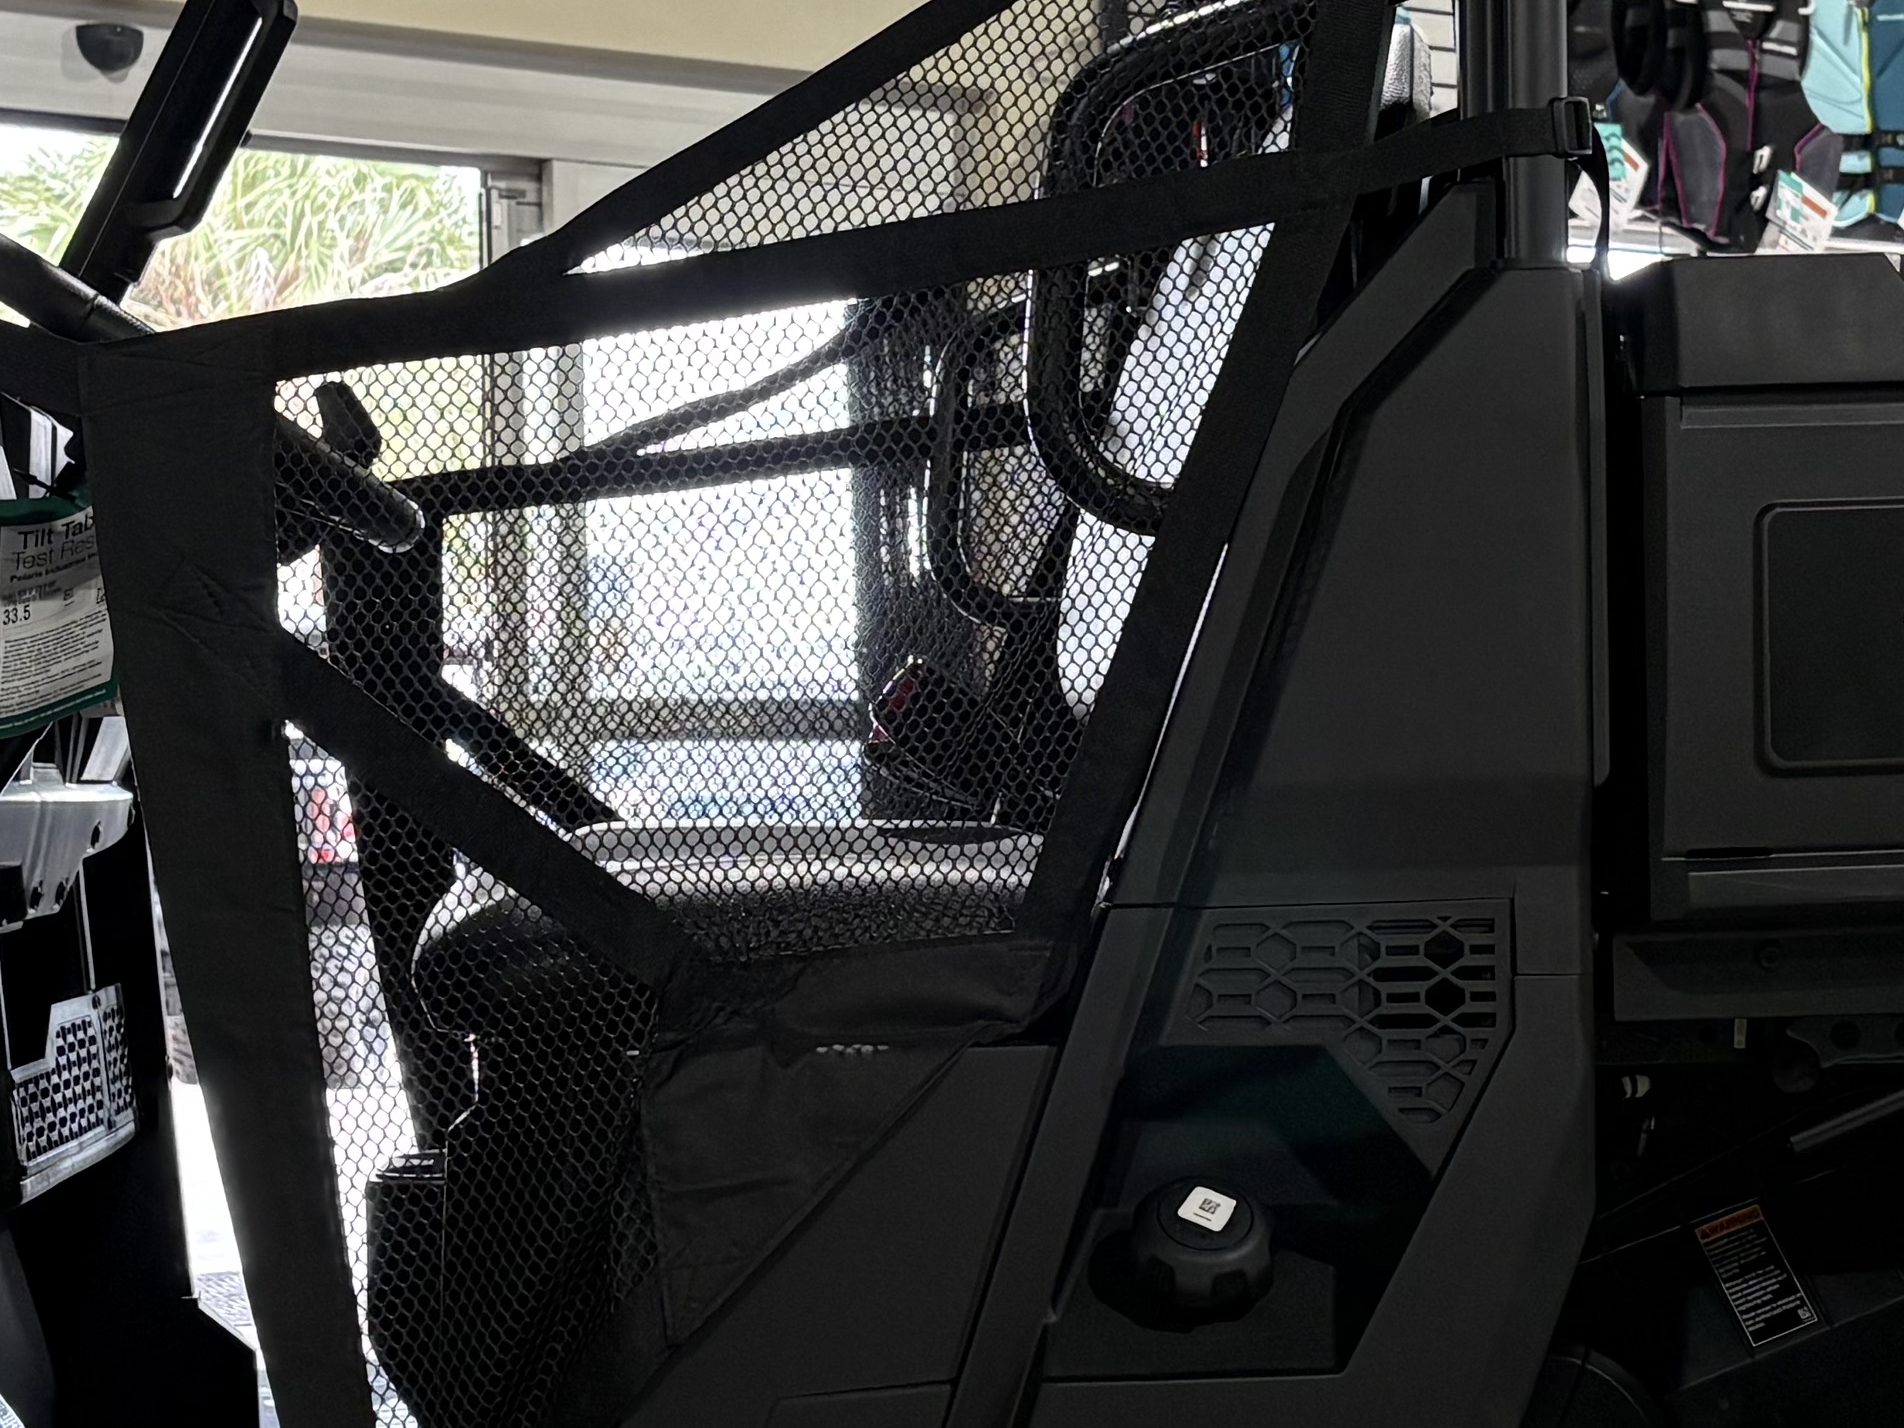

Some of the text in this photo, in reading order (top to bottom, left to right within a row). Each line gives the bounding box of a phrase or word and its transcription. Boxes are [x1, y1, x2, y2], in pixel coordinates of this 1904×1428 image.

[18, 529, 53, 550] Tilt
[12, 549, 53, 570] Test
[3, 604, 31, 625] 33.5
